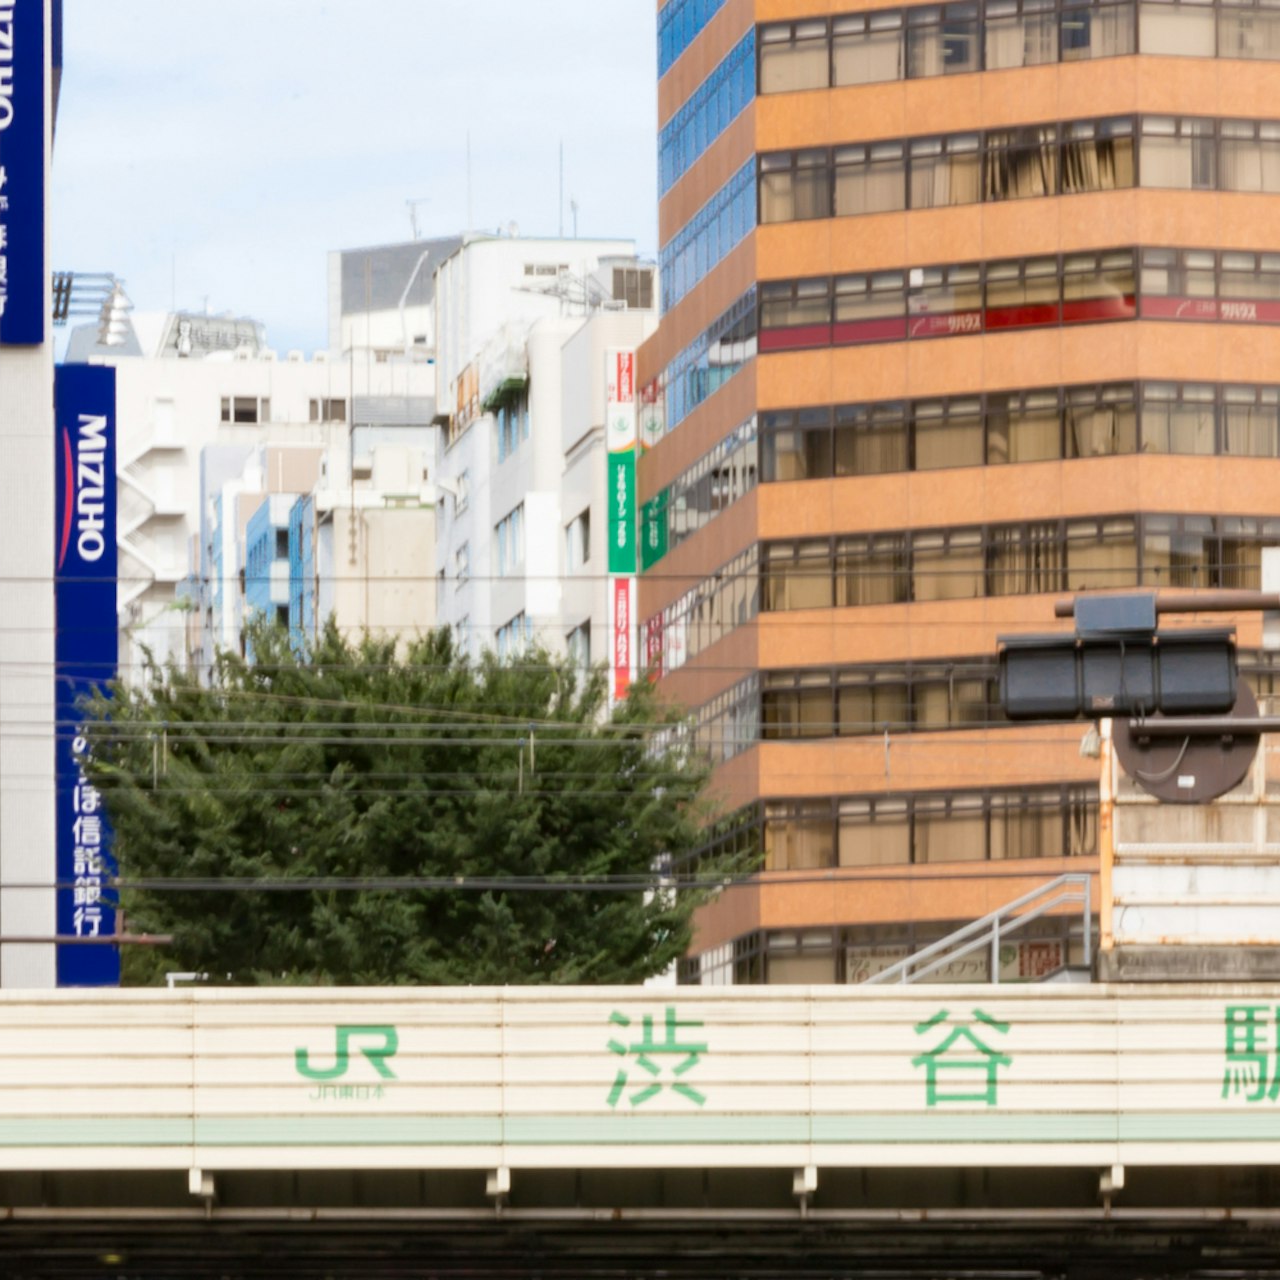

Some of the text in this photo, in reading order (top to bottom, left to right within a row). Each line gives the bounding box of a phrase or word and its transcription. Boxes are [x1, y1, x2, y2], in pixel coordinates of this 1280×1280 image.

[78, 414, 107, 562] MIZUHO
[73, 725, 102, 937] ほ信託銀行
[296, 1024, 398, 1079] JR
[309, 1084, 387, 1100] JR東日本
